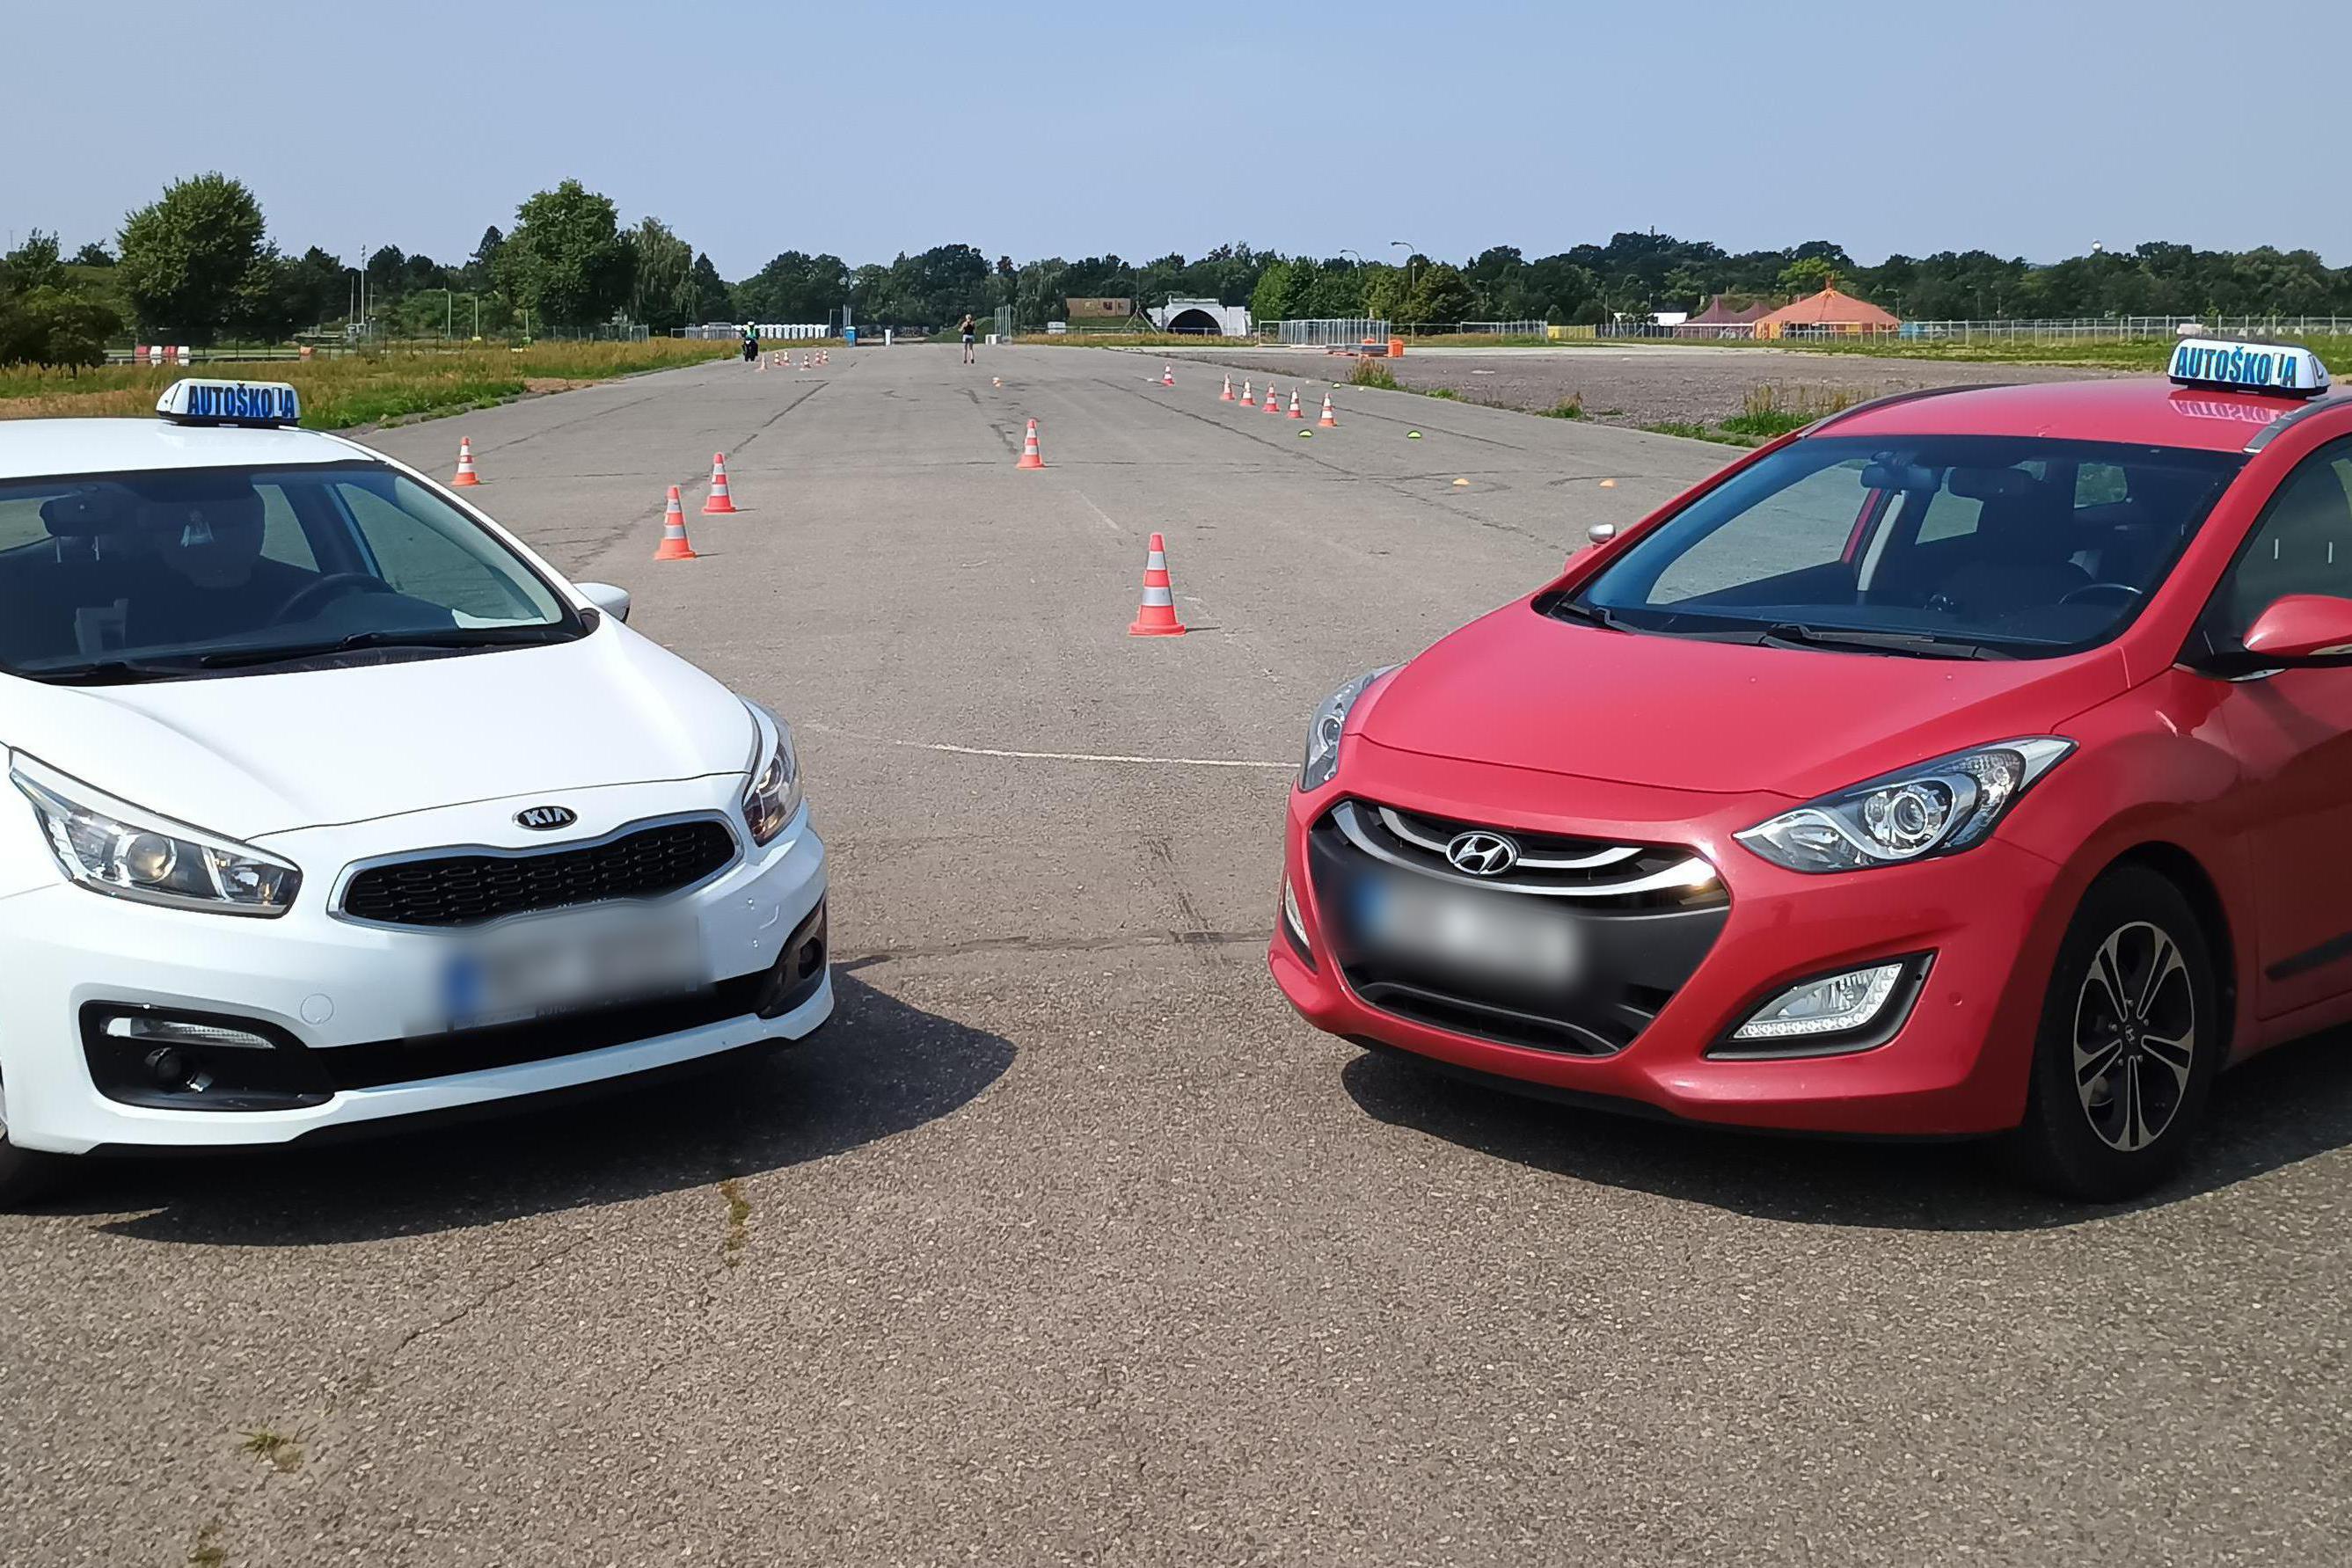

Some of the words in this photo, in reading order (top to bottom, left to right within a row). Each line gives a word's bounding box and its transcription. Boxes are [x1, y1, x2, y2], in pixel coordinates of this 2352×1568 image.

[2175, 346, 2297, 387] AUTOŠKOLA
[187, 383, 296, 418] AUTOŠKOLA
[523, 807, 571, 826] KIA
